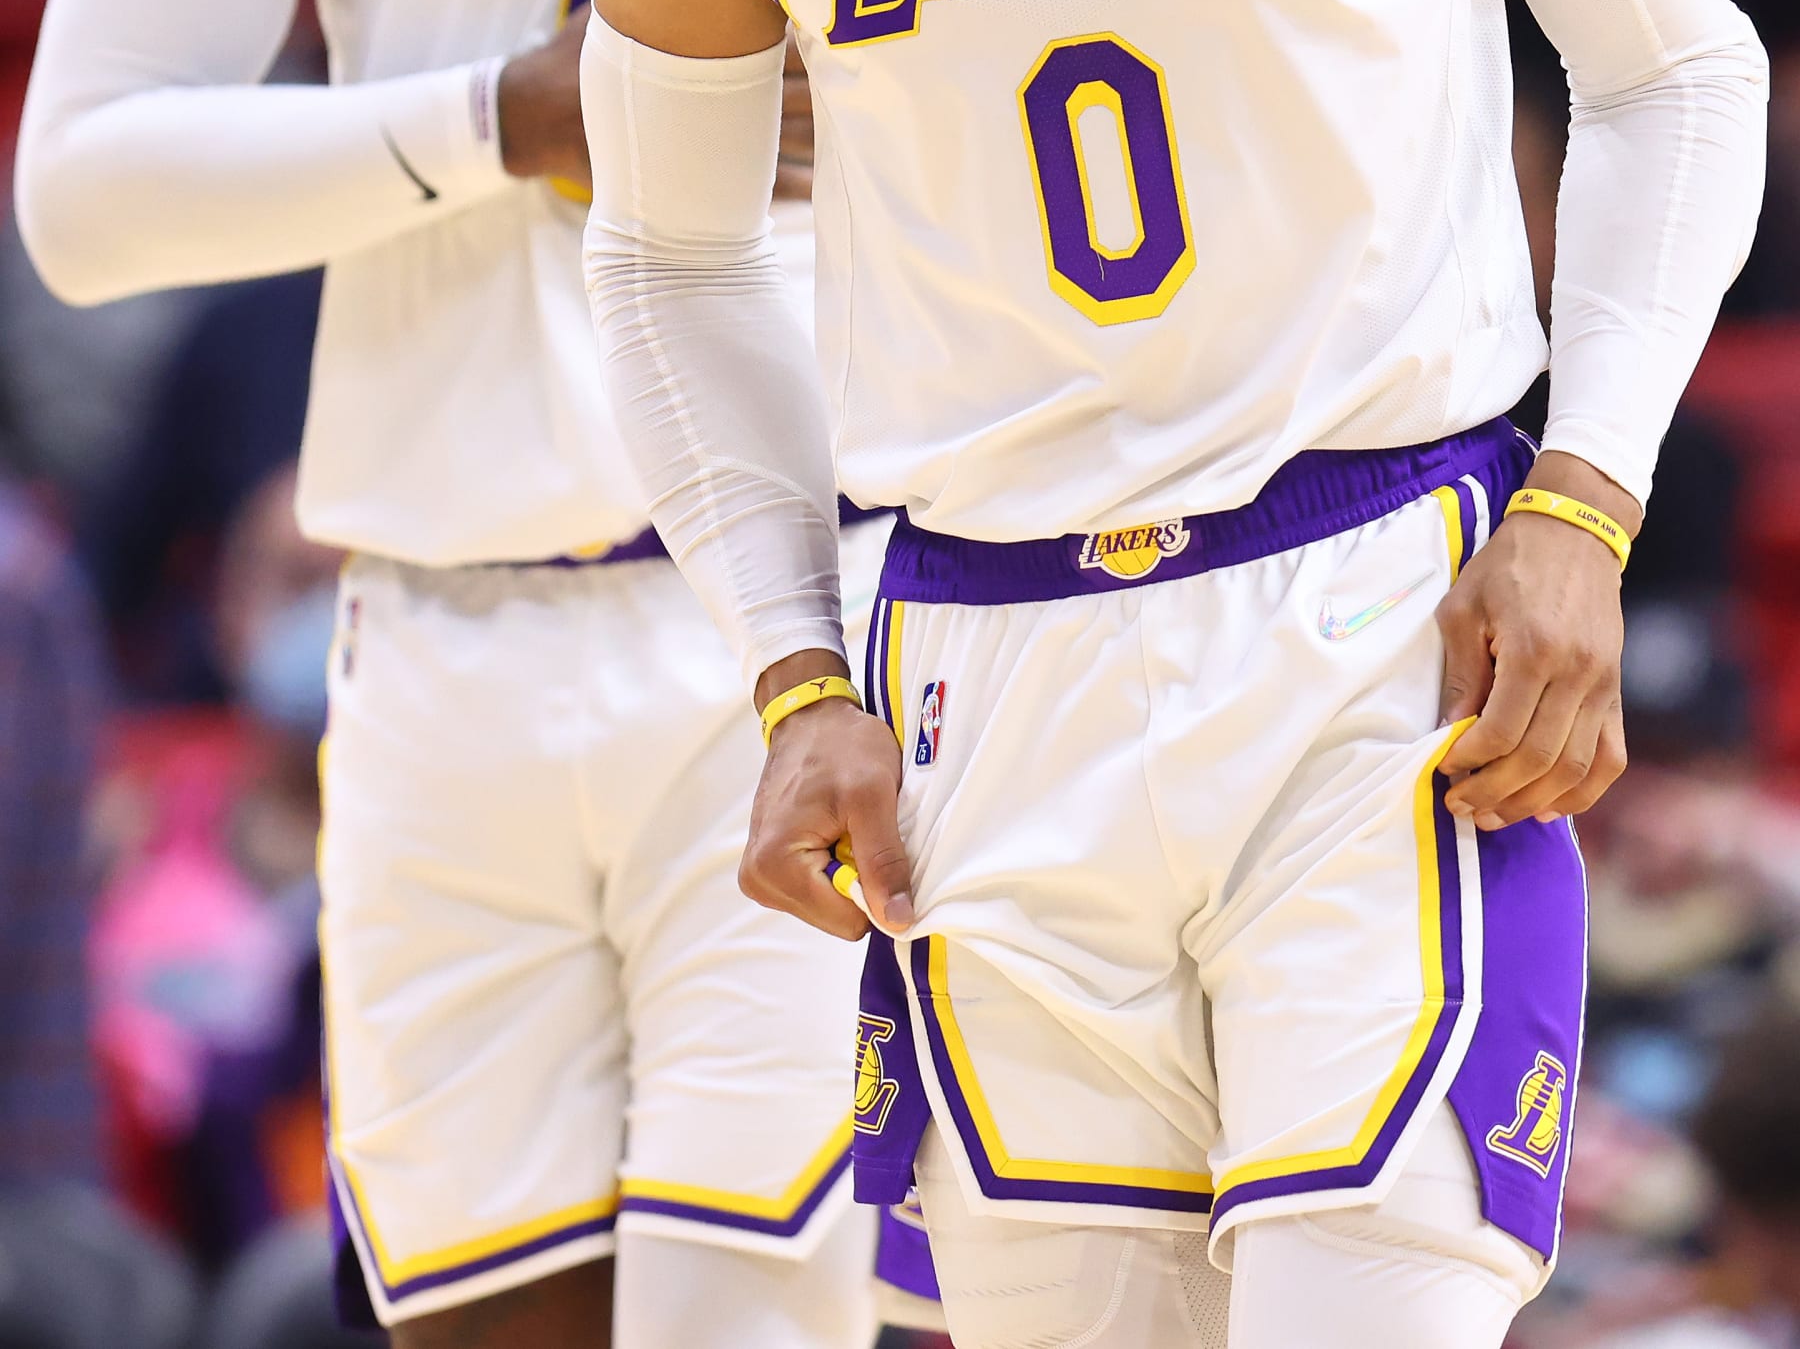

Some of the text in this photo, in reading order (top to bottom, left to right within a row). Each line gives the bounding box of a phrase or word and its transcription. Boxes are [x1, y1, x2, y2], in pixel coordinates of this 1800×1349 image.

[1015, 31, 1198, 327] 0
[1079, 522, 1187, 564] LAKERS
[1600, 521, 1617, 538] WHY
[917, 743, 928, 763] 75
